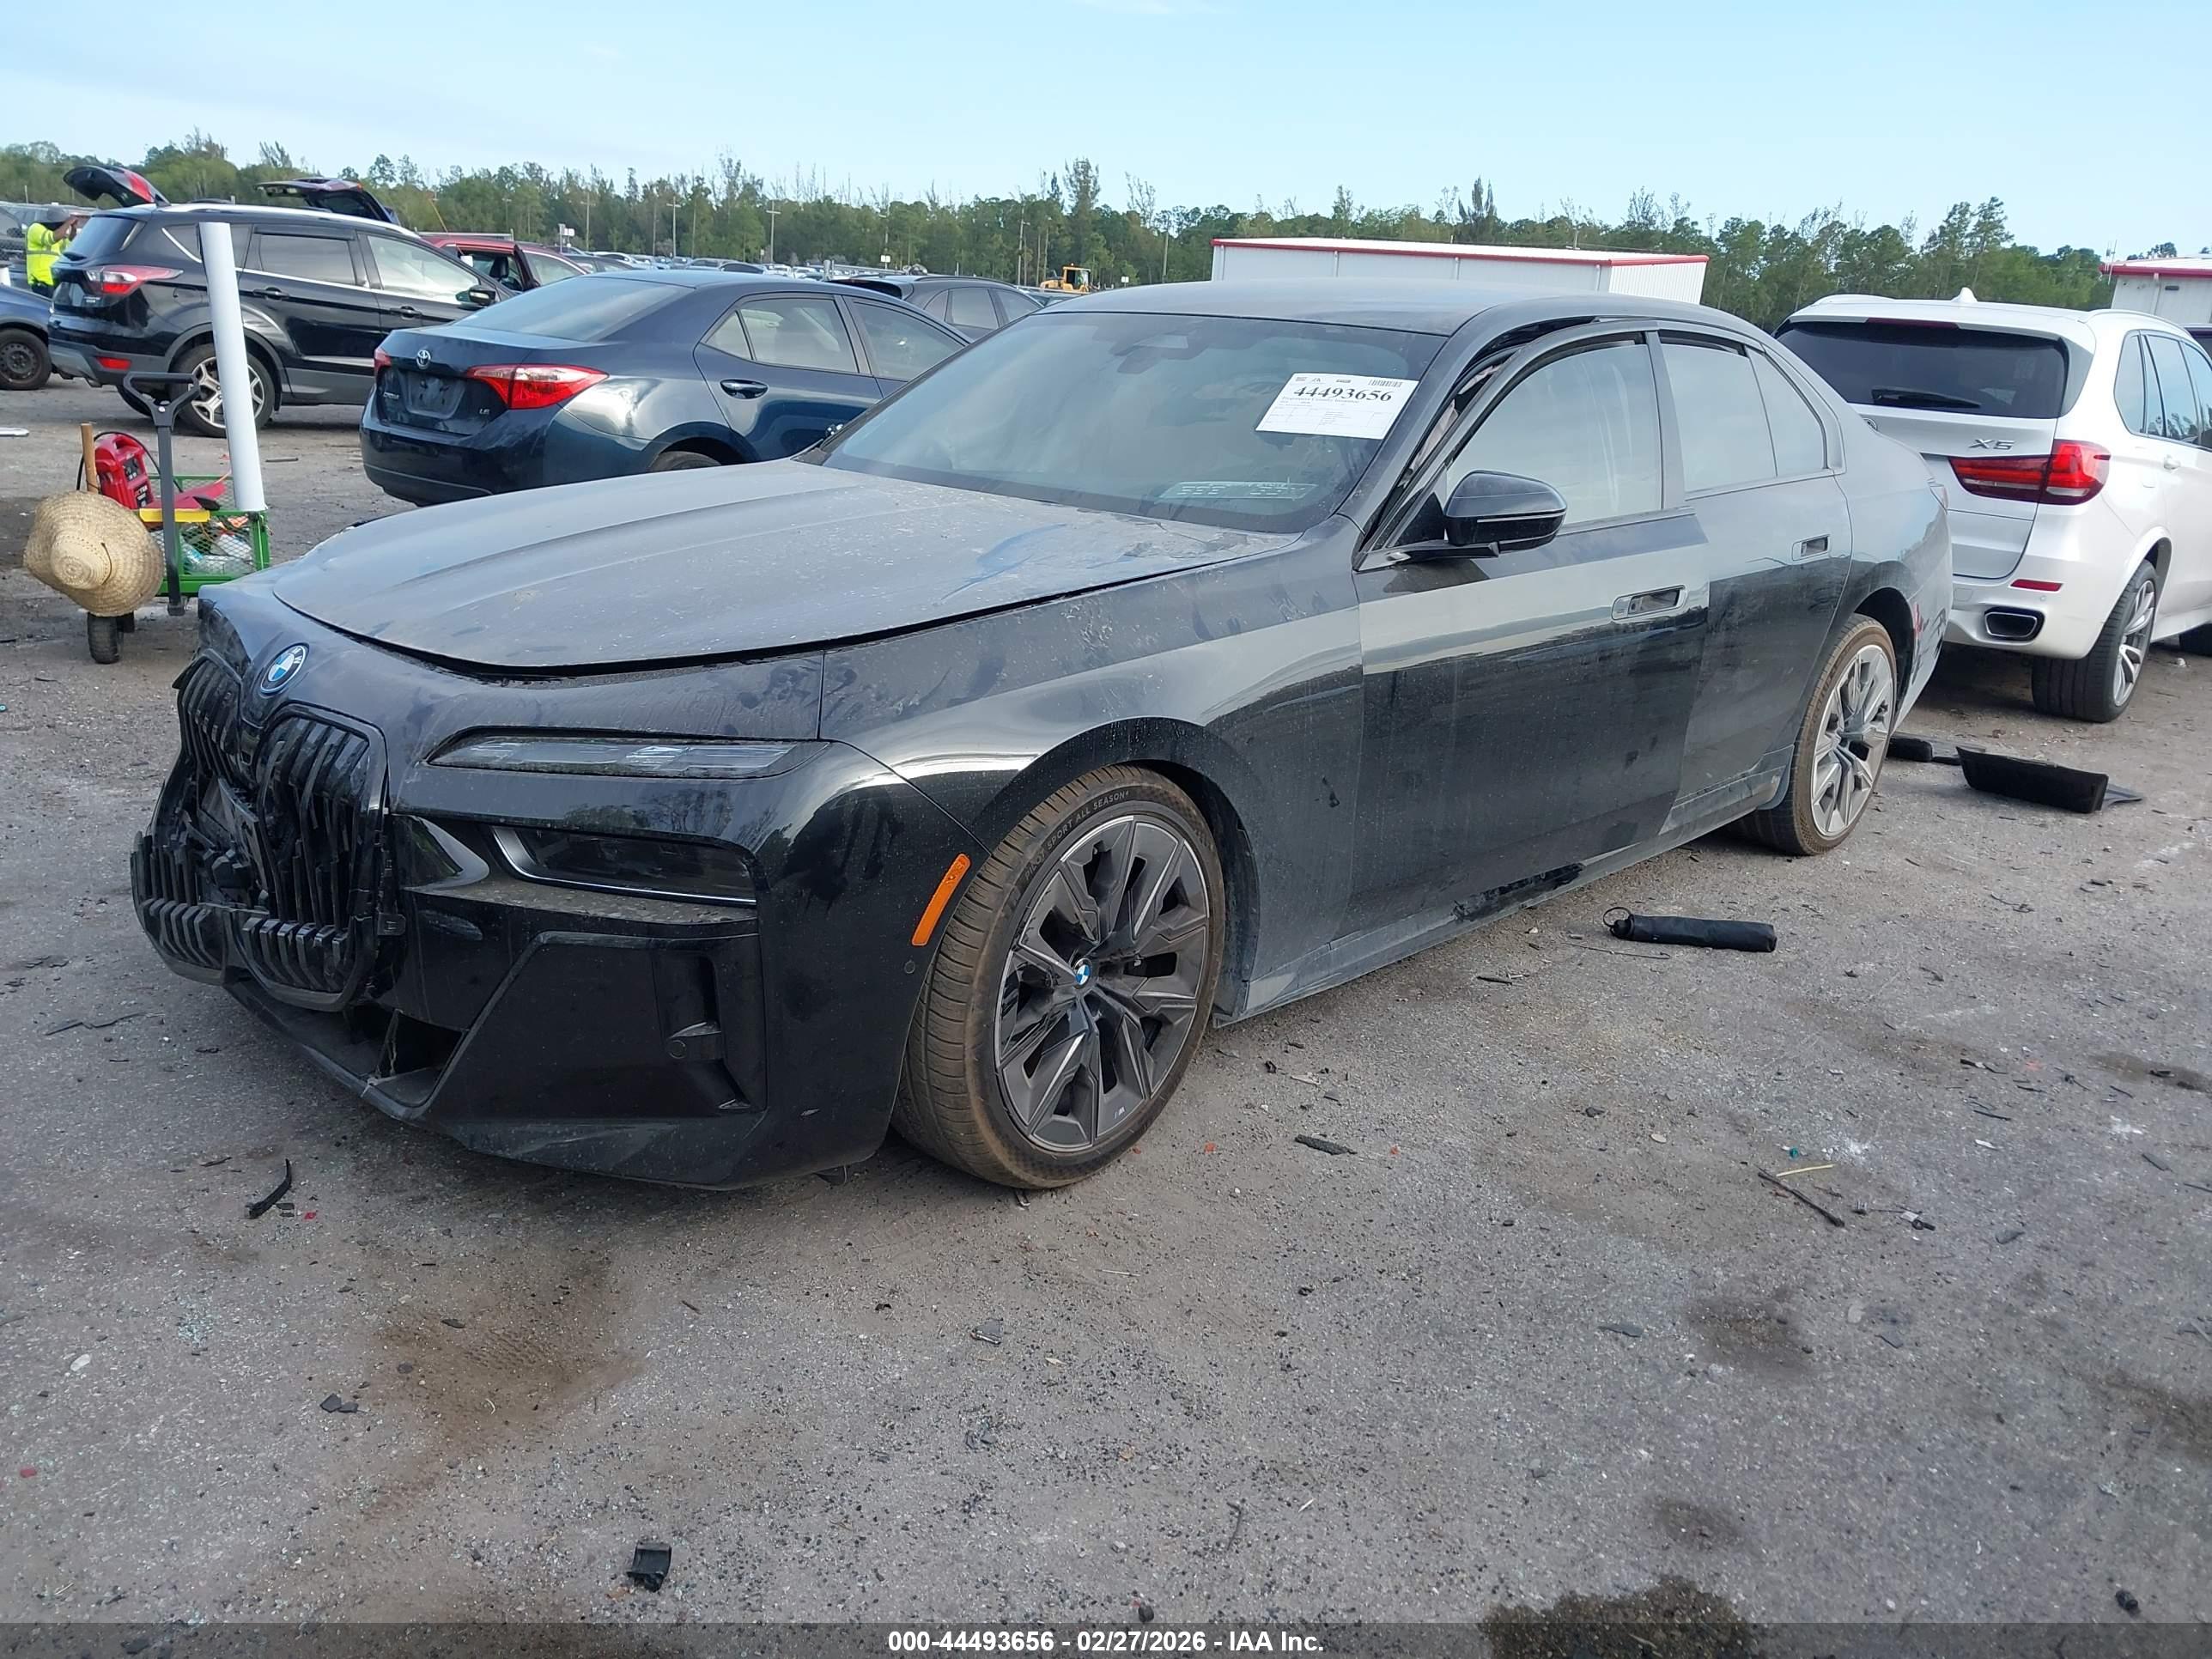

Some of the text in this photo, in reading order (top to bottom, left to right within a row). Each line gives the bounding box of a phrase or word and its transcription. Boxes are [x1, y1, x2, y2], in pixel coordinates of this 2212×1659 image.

[1293, 386, 1395, 402] 44493656
[1969, 438, 2016, 451] X5
[1024, 851, 1046, 881] PILOT
[1047, 820, 1073, 850] SPORT
[1075, 806, 1092, 822] ALL
